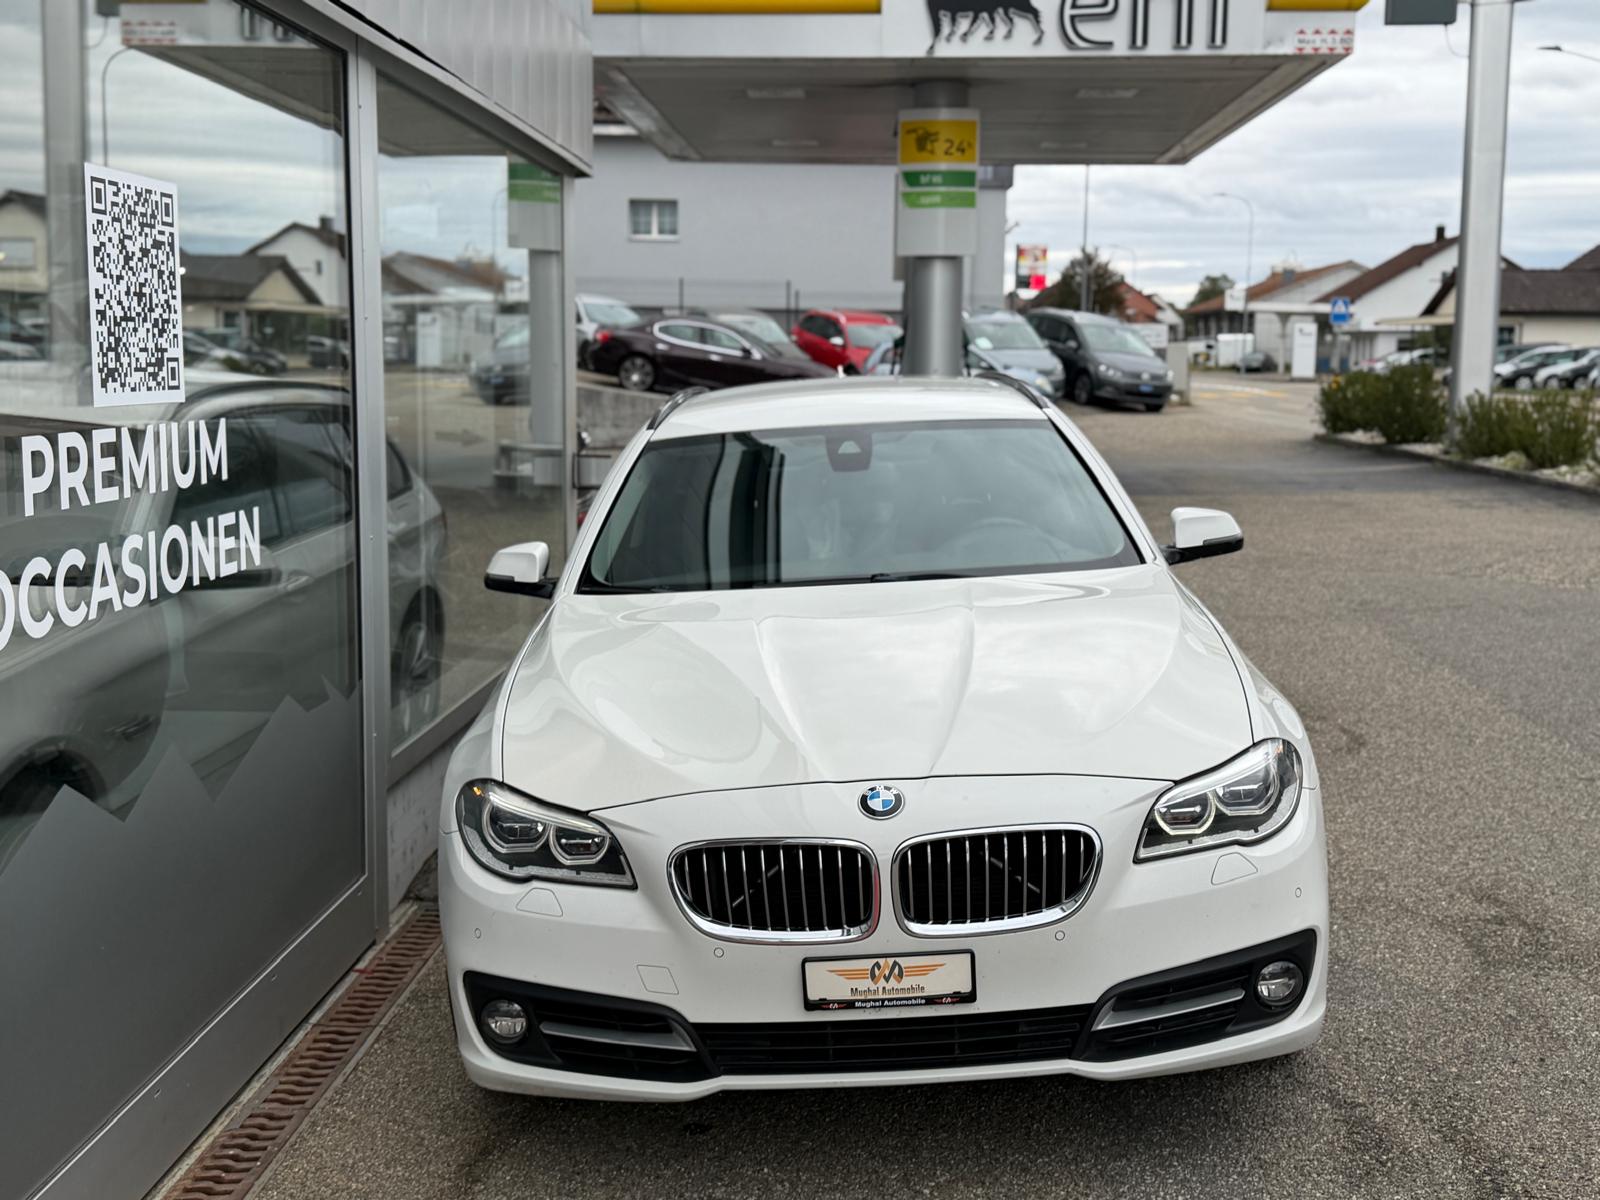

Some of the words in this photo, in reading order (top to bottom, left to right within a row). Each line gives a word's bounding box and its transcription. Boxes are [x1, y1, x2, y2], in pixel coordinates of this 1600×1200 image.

[21, 418, 229, 517] PREMIUM
[850, 986, 880, 999] Mughal
[881, 984, 926, 996] Automobile
[855, 1000, 882, 1008] Mughal
[883, 998, 926, 1006] Automobile
